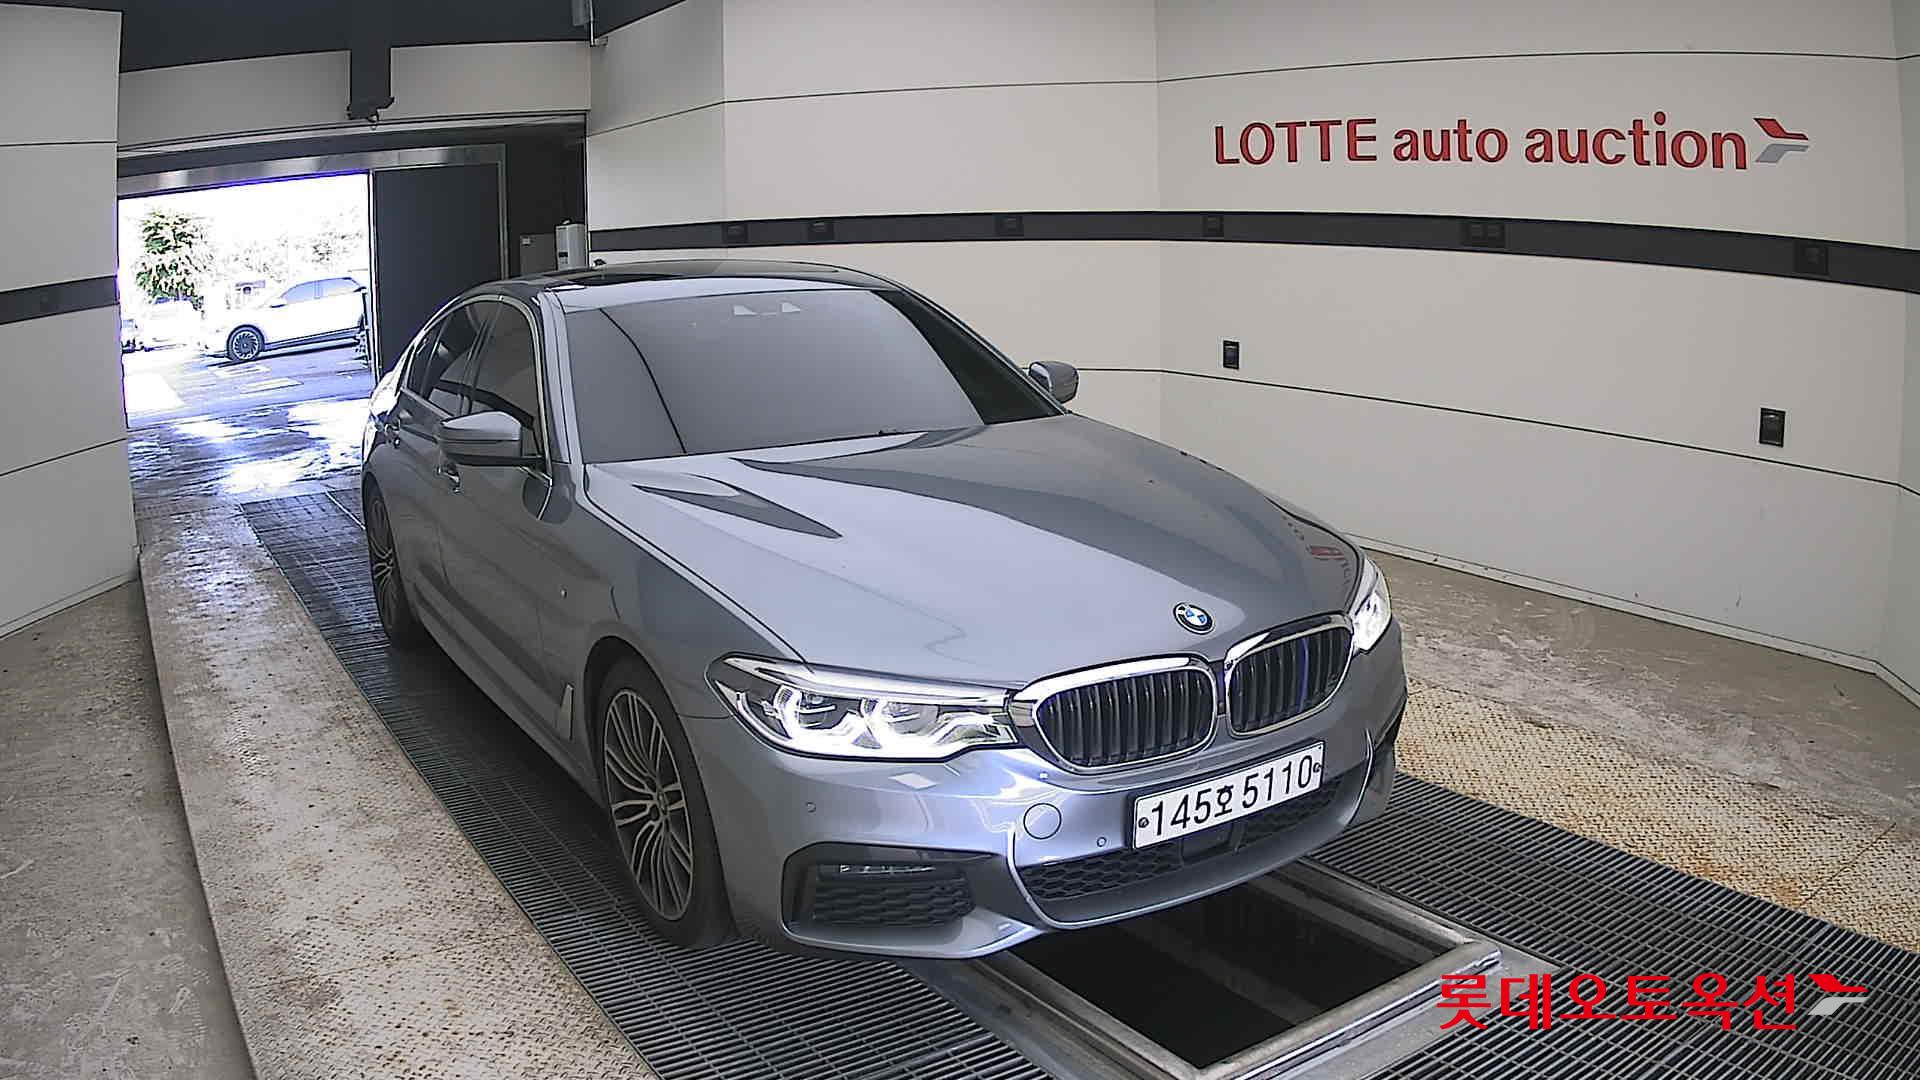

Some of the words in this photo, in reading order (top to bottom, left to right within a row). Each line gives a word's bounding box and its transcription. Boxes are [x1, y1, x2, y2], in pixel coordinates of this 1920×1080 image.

[1214, 118, 1377, 165] LOTTE
[1392, 118, 1509, 163] auto
[1524, 111, 1748, 170] auction
[1242, 754, 1313, 809] 5110
